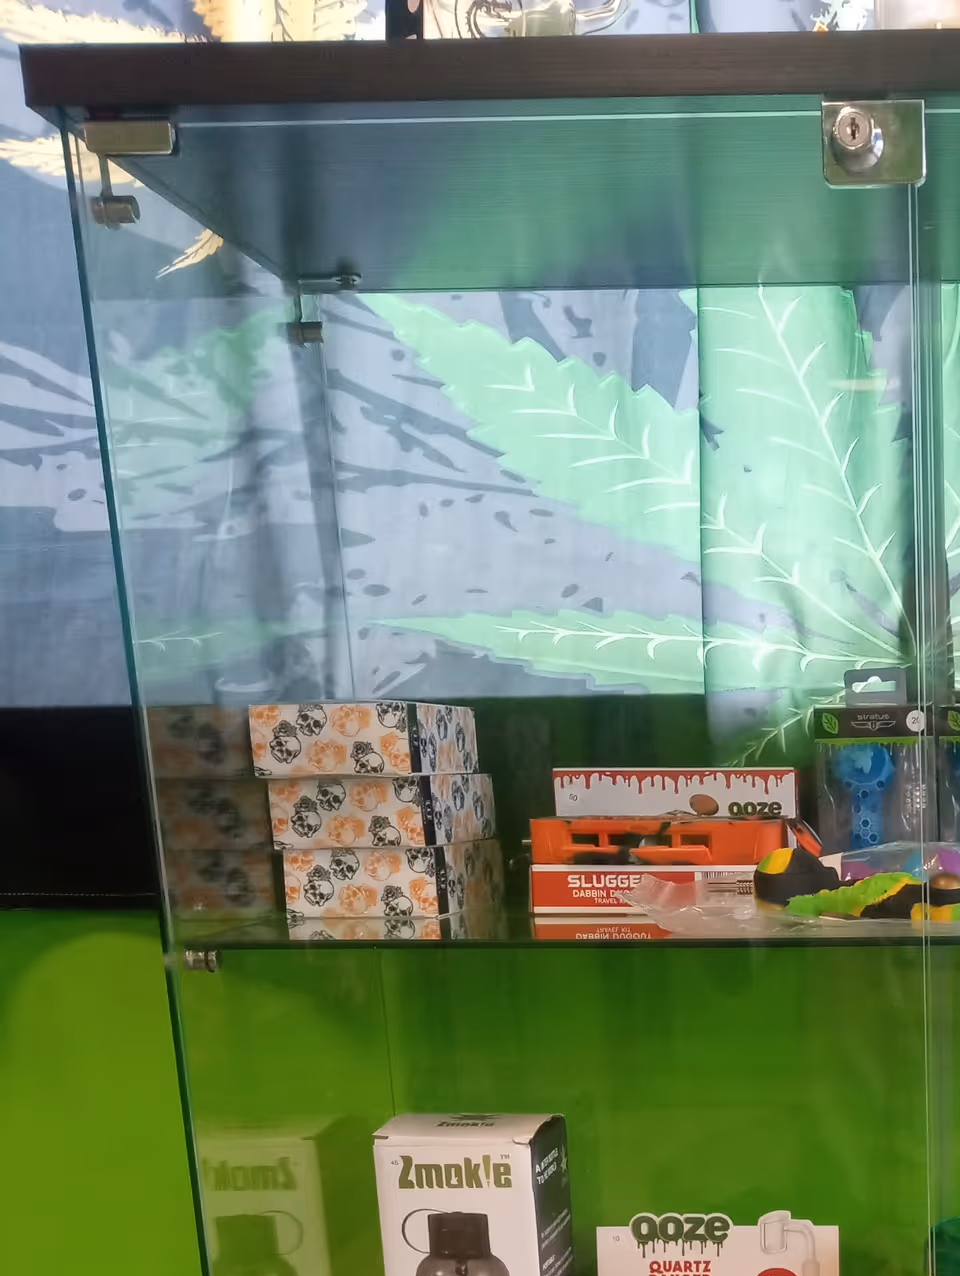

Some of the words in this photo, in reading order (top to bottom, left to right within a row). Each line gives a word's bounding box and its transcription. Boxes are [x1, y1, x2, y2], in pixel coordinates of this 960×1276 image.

[728, 801, 782, 816] ooze
[572, 889, 607, 898] DABBIN
[630, 1214, 731, 1244] ooze
[649, 1260, 711, 1274] QUARTZ
